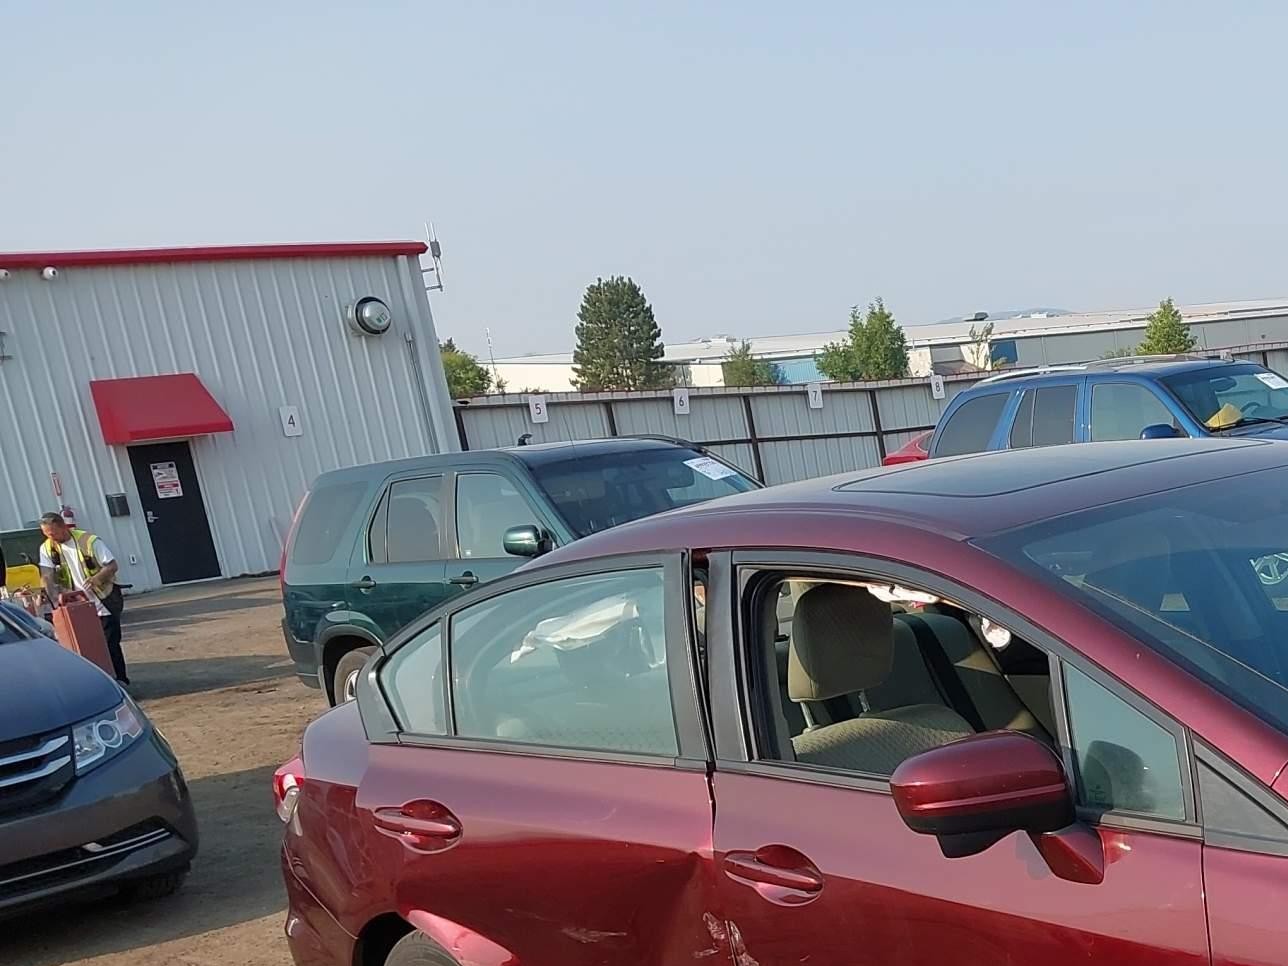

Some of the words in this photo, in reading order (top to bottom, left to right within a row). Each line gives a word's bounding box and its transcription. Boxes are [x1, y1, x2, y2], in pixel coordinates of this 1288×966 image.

[935, 381, 941, 392] 8
[678, 395, 685, 407] 6
[812, 390, 818, 402] 7
[534, 402, 542, 415] 5
[287, 414, 296, 428] 4
